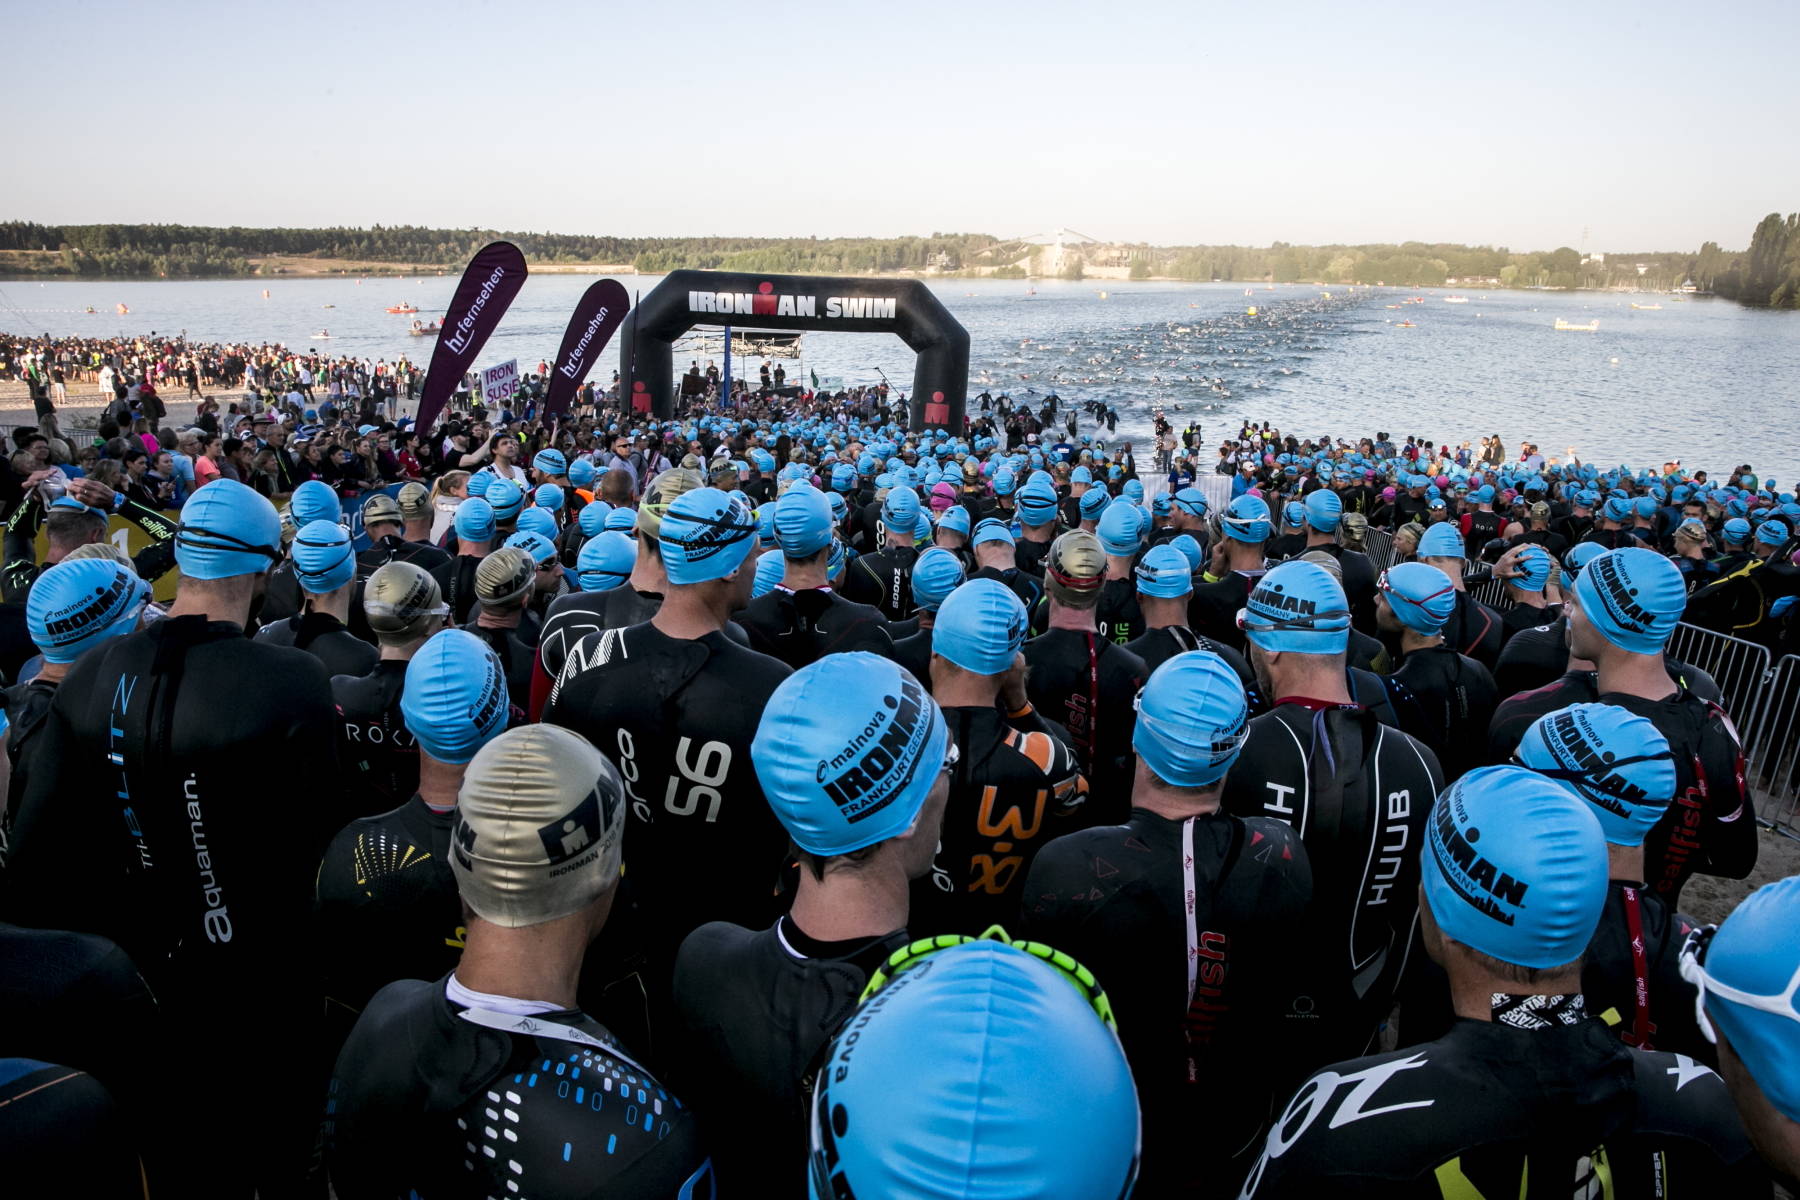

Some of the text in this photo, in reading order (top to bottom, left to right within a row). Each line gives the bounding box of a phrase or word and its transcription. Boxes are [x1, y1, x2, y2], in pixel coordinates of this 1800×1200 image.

[688, 281, 896, 319] IRONMAN SWIM
[485, 364, 514, 385] IRON
[487, 379, 520, 404] SUSIE
[139, 516, 174, 540] sailfish
[1615, 555, 1633, 586] mainova
[43, 570, 129, 636] IRONMAN
[53, 593, 94, 618] mainova
[1599, 555, 1658, 626] IRONMAN
[830, 710, 887, 770] mainova
[1577, 713, 1605, 748] mainova
[1553, 709, 1648, 802] IRONMAN
[617, 727, 654, 824] orca
[840, 753, 912, 817] FRANKFURT
[549, 850, 599, 879] IRONMAN
[1366, 789, 1411, 906] HUUB
[1637, 976, 1646, 1007] sailfish
[835, 979, 912, 1084] mainova
